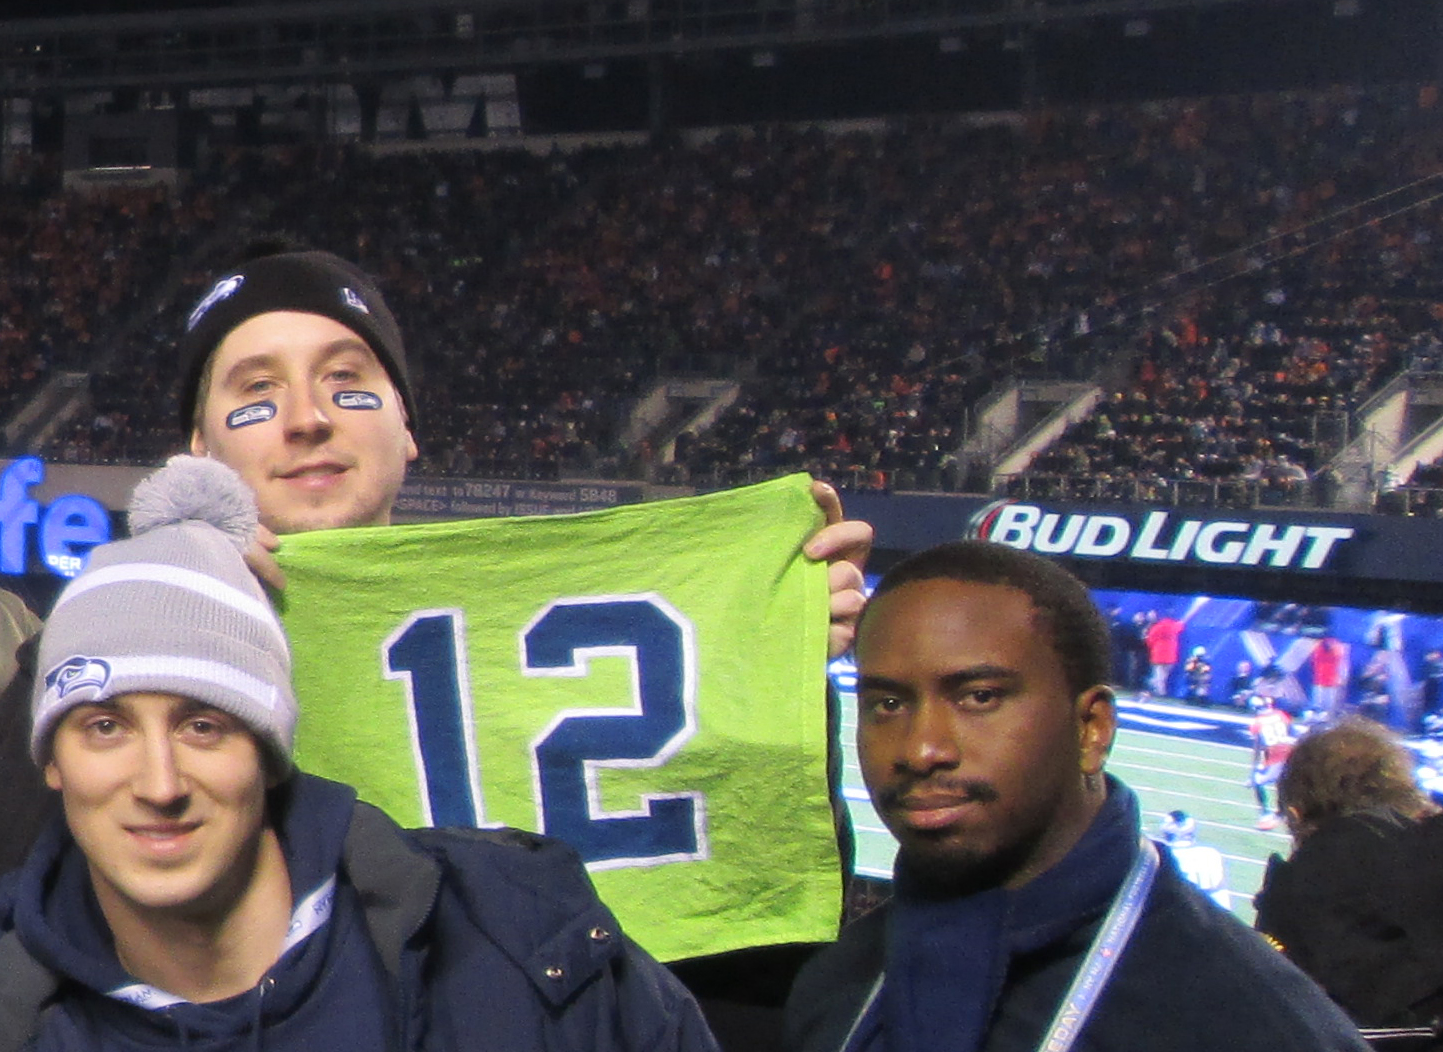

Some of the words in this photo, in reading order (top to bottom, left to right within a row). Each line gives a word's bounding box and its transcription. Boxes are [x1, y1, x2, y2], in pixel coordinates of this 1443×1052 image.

[990, 505, 1131, 557] BUD
[1131, 510, 1355, 570] LIGHT
[381, 591, 711, 873] 12
